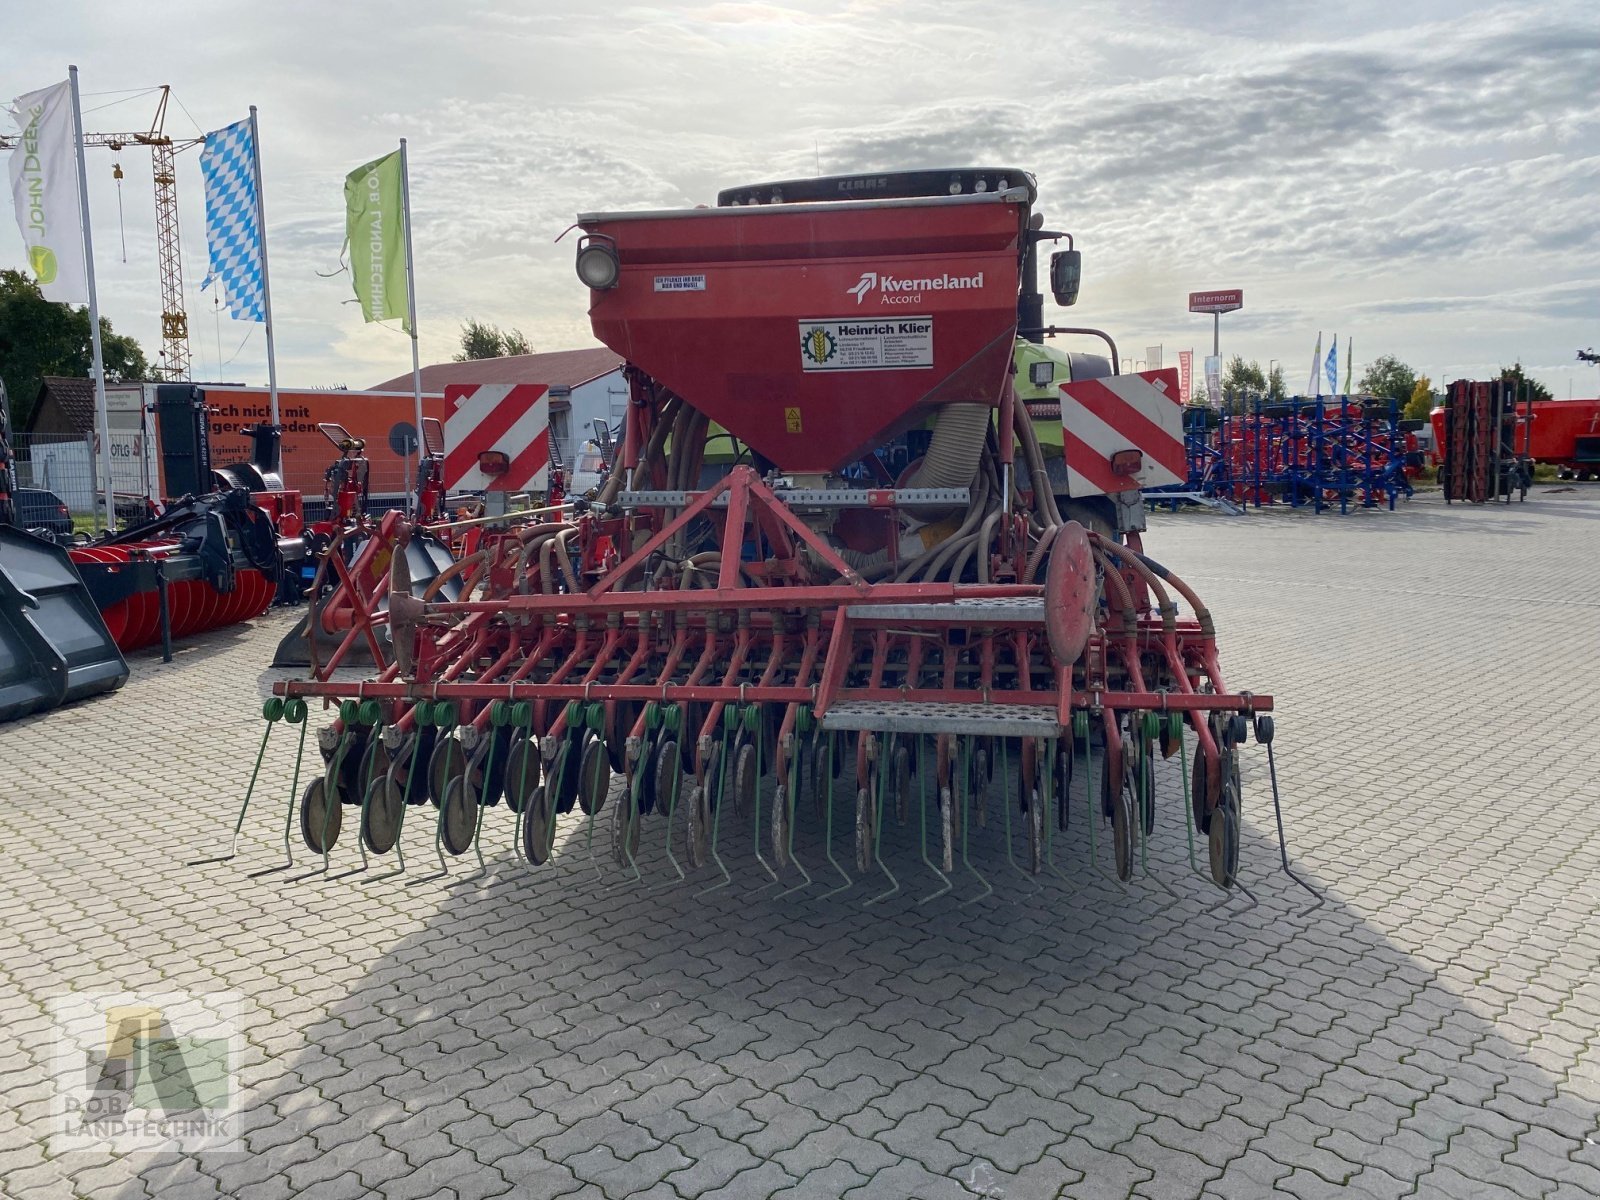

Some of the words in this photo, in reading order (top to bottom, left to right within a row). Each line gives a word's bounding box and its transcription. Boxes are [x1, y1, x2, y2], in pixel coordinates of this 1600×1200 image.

[838, 178, 888, 191] CLAAS
[28, 177, 45, 238] JOHN
[881, 272, 984, 293] Kverneland
[880, 293, 921, 305] Accord
[1194, 293, 1236, 304] Internorm
[838, 324, 894, 336] Heinrich
[898, 323, 931, 334] Klier
[242, 404, 281, 418] nich
[285, 405, 310, 418] mit
[110, 444, 130, 457] OTLG
